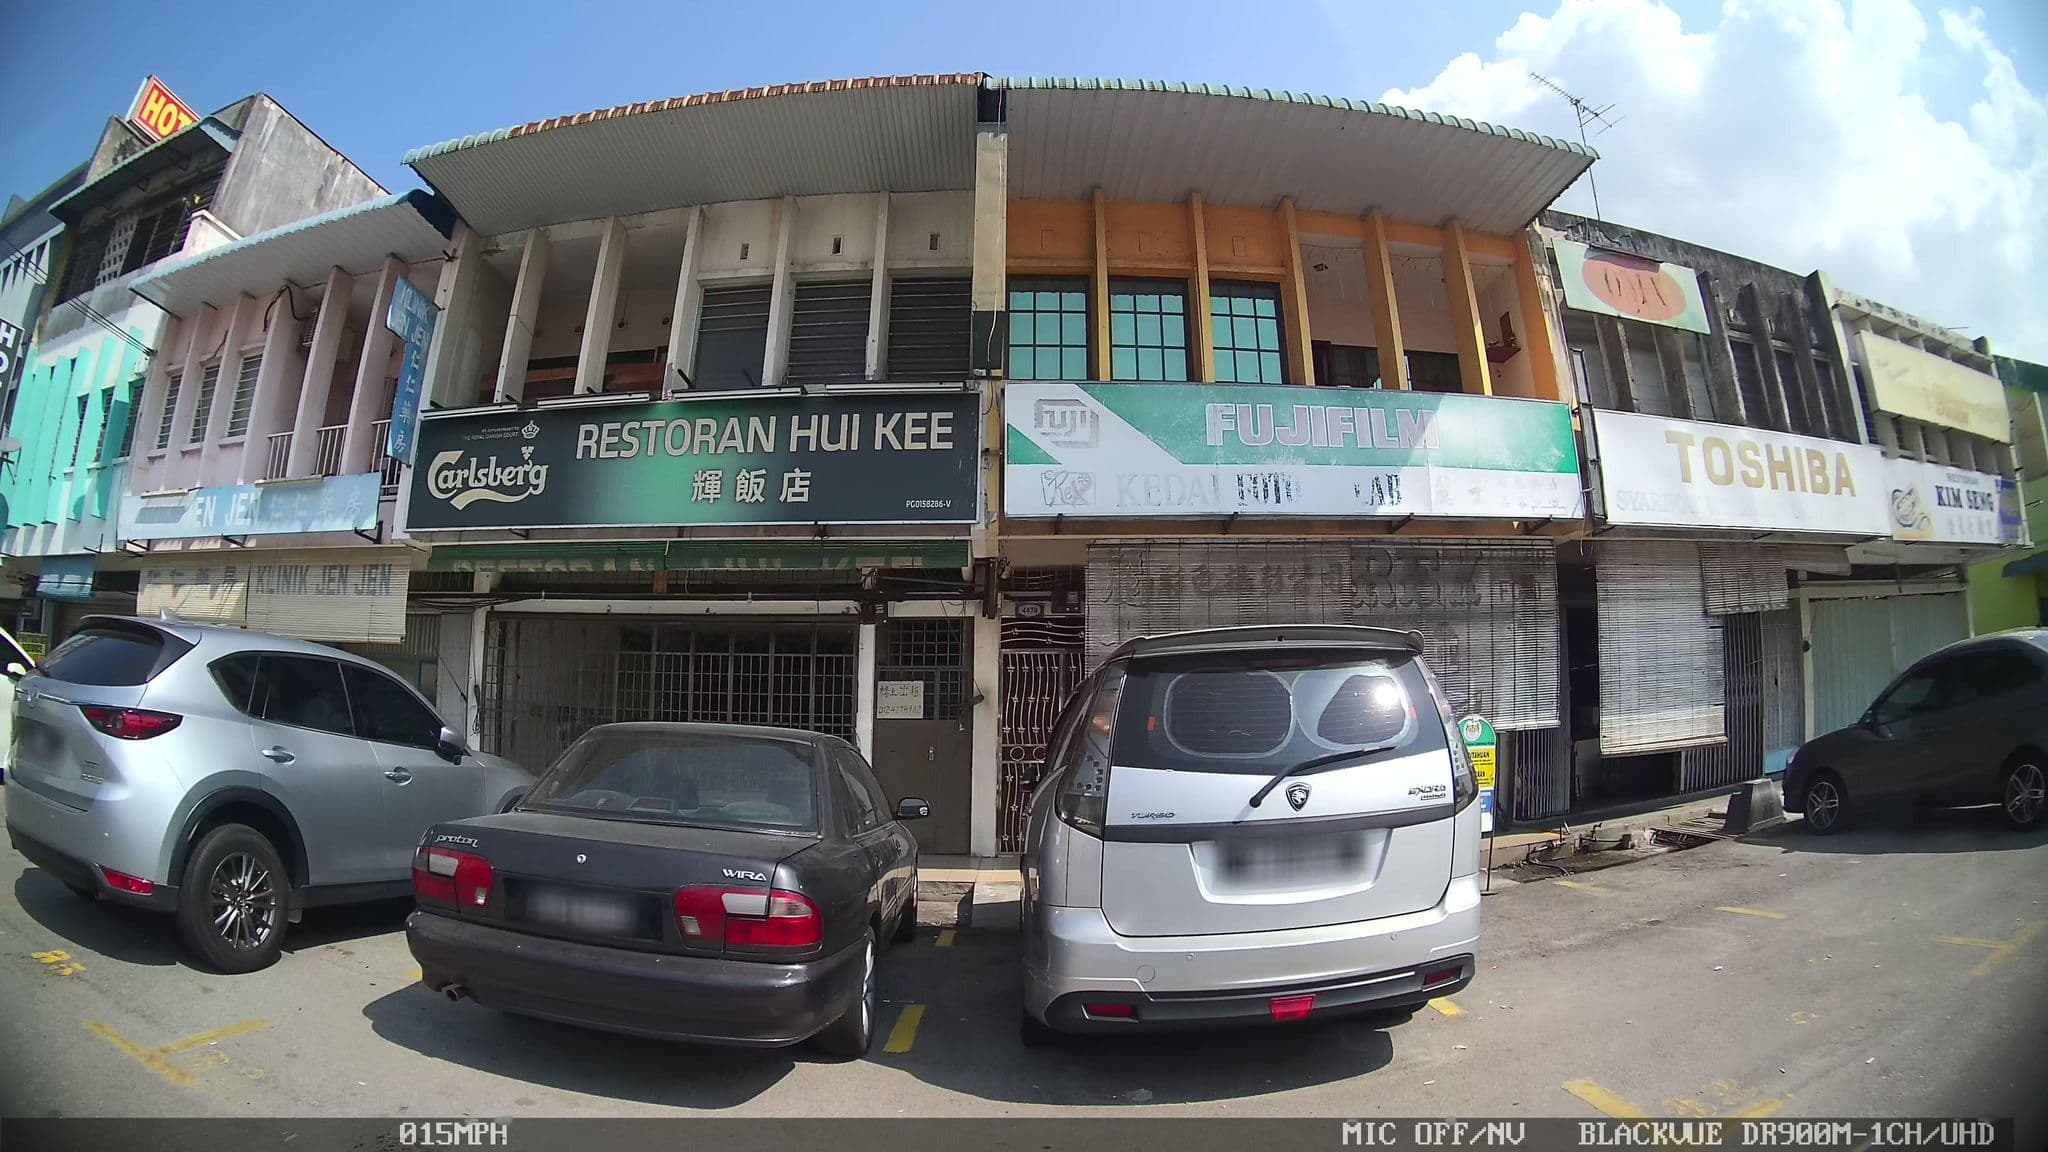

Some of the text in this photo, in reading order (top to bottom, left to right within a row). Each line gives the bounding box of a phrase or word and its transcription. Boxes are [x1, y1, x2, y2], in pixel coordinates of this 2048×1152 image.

[575, 411, 954, 460] RESTORAN HUI KEE
[1205, 403, 1440, 449] FUJIFILM
[427, 450, 549, 500] Carlsberg
[1664, 430, 1857, 497] TOSHIBA
[691, 468, 812, 503] 輝飯店
[1935, 485, 1963, 509] KIM
[255, 565, 310, 595] KLINIK
[316, 564, 350, 596] JEN
[354, 563, 393, 596] JEN
[434, 833, 478, 848] proton
[722, 868, 767, 881] WIRA
